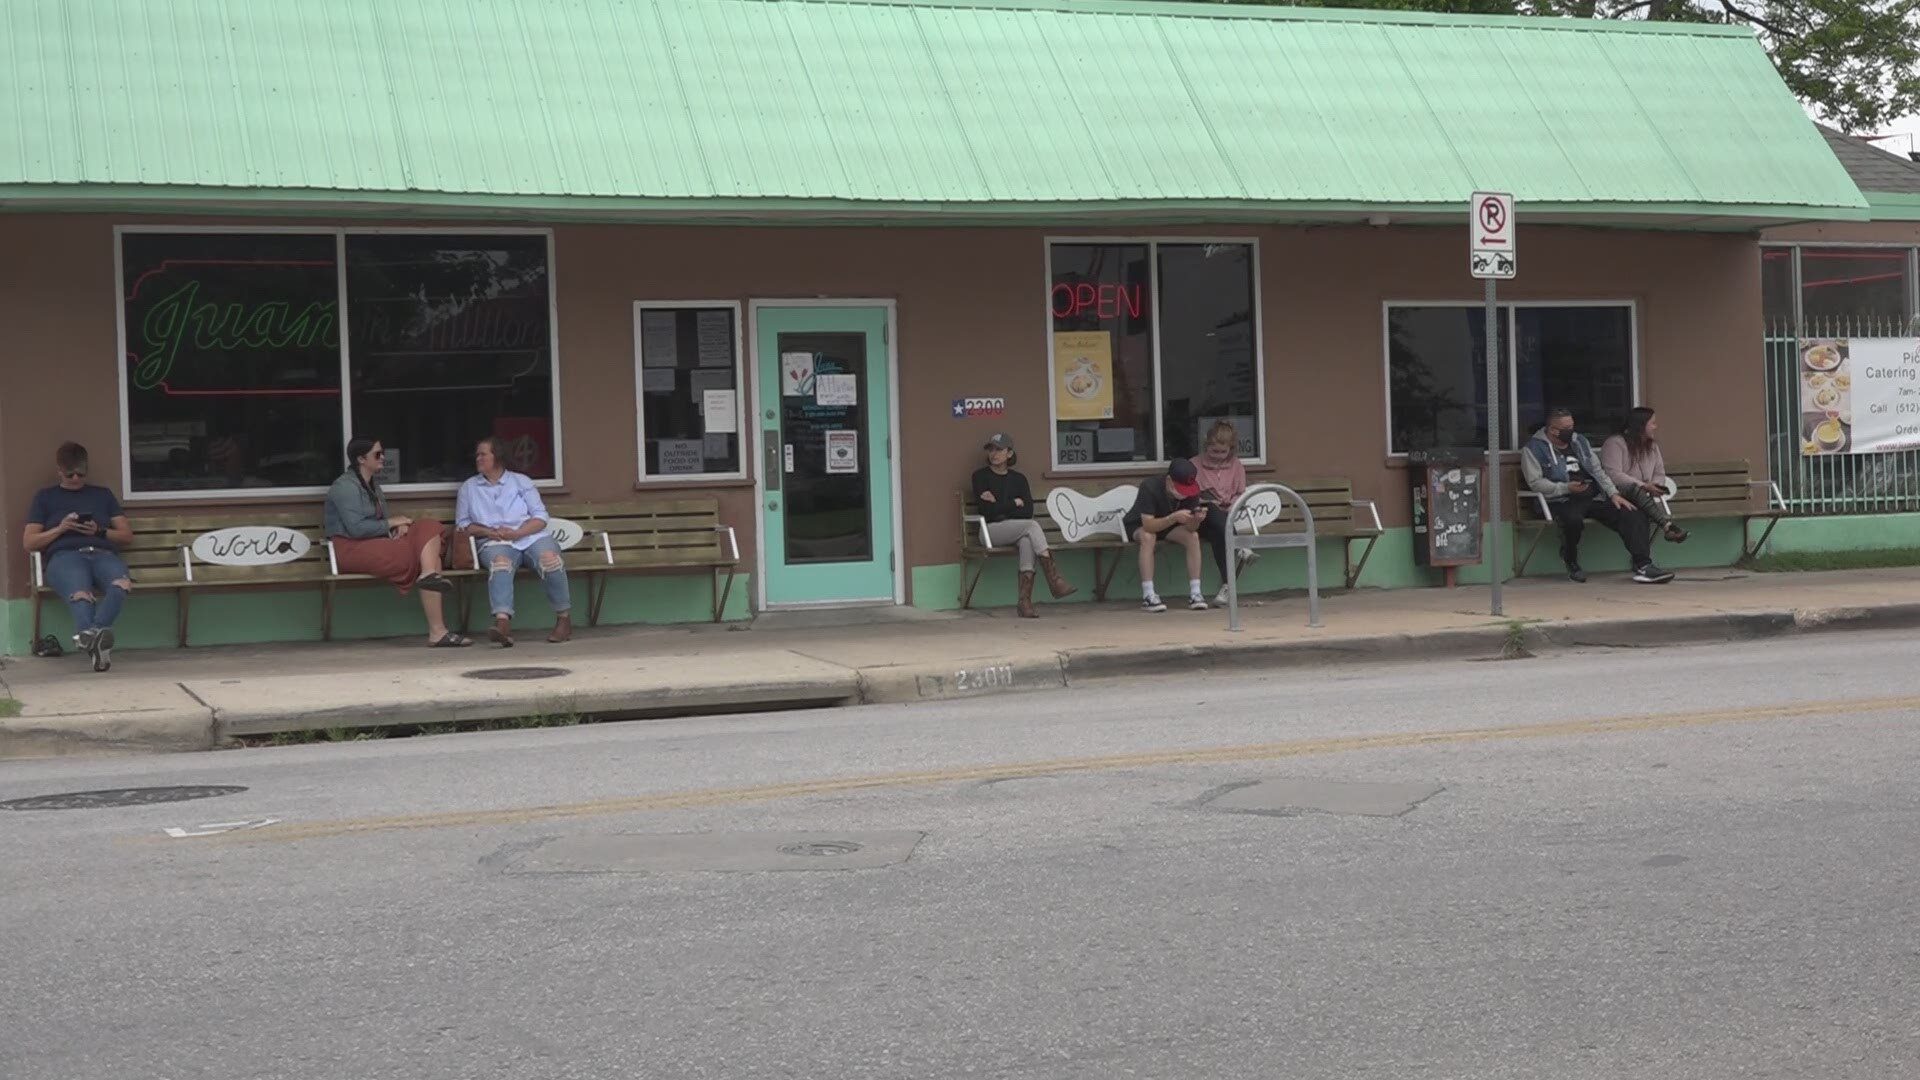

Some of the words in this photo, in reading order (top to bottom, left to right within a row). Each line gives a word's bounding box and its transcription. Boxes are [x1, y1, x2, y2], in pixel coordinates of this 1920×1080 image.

[1051, 283, 1141, 319] OPEN
[134, 280, 340, 390] Juan
[1865, 366, 1916, 380] Catering
[966, 400, 1003, 416] 2300
[1870, 404, 1888, 413] Call
[1065, 434, 1082, 446] NO
[1060, 450, 1088, 462] PETS
[208, 530, 298, 557] World
